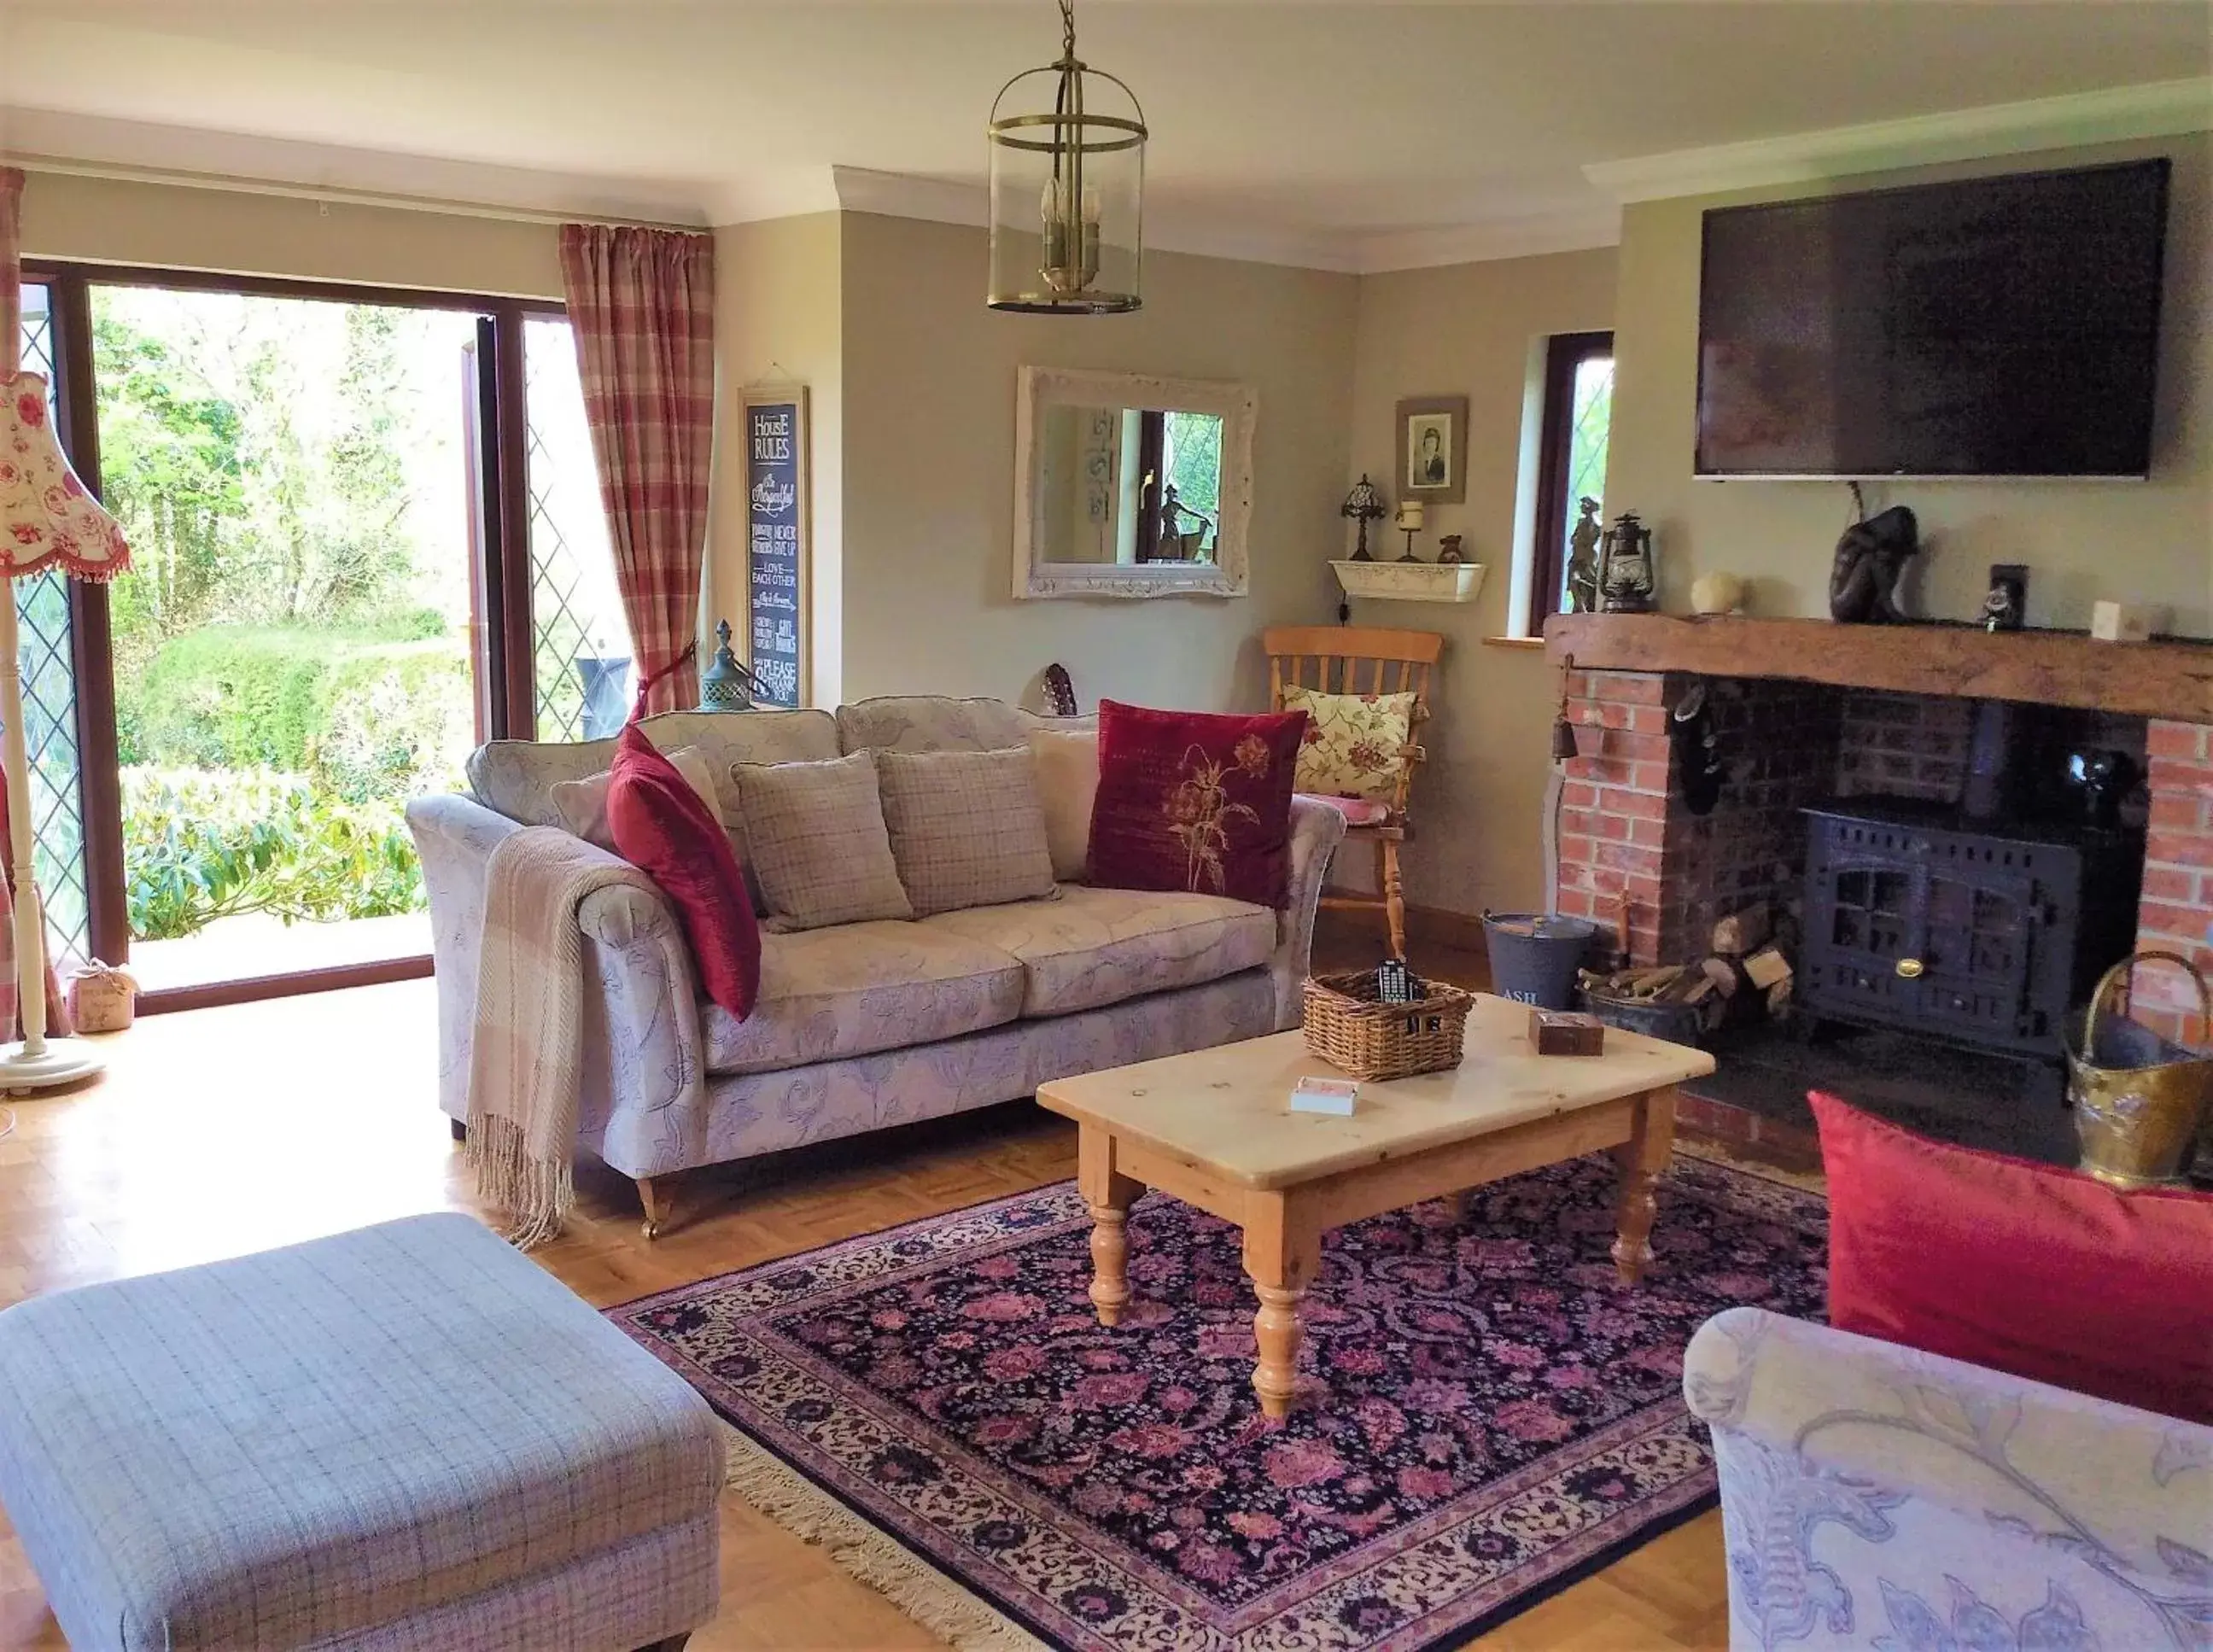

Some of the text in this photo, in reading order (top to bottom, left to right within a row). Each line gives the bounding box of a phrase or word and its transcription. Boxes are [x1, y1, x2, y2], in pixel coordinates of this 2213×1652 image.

[755, 438, 789, 459] RULES
[763, 563, 783, 574] LOVE
[752, 571, 796, 587] EACH OTHER
[764, 659, 796, 678] PLEASE
[766, 677, 796, 692] THANK
[774, 691, 788, 701] YOU
[1504, 989, 1537, 1005] ASH
